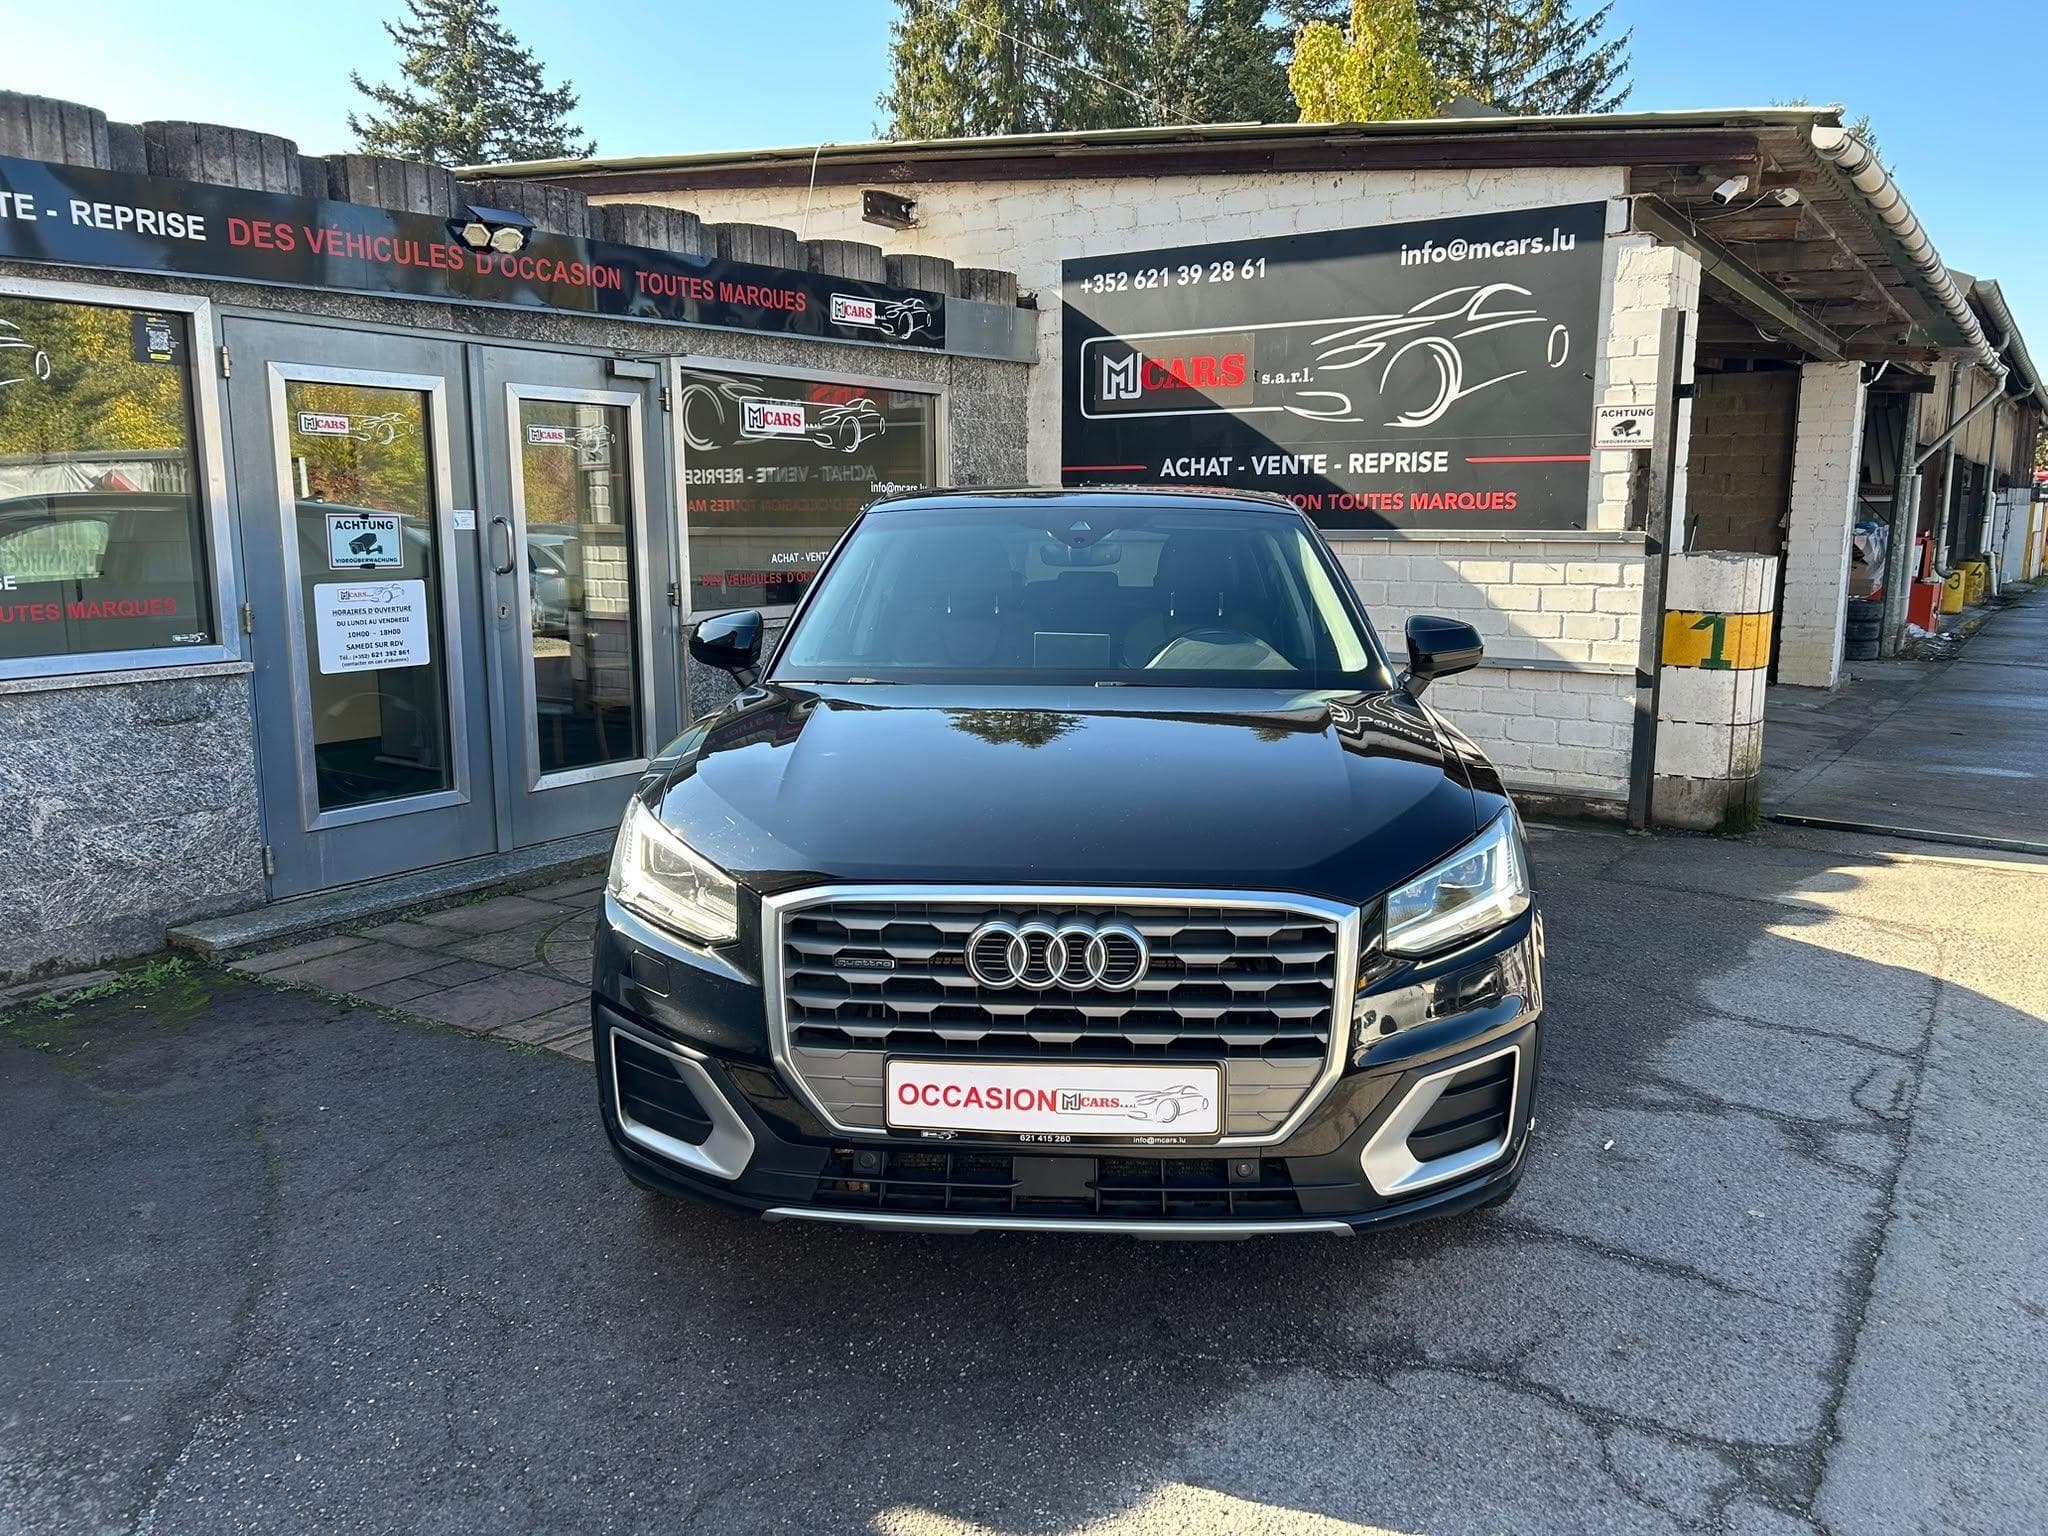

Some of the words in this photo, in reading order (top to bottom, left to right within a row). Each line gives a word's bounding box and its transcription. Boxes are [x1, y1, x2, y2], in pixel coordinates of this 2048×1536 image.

[46, 209, 58, 217] -
[69, 199, 207, 241] REPRISE
[1400, 227, 1576, 266] info@mcars.lu
[227, 217, 296, 252] DES
[303, 223, 464, 271] VÉHICULES
[475, 251, 622, 291] D'OCCASION
[635, 271, 715, 301] TOUTES
[719, 281, 808, 312] MARQUES
[1080, 271, 1128, 294] +352
[1134, 267, 1169, 290] 621
[1177, 264, 1203, 286] 39
[1208, 261, 1235, 283] 28
[1241, 257, 1266, 280] 61
[1261, 368, 1314, 384] s.a.r.l.
[1601, 408, 1654, 417] ACHTUNG
[1160, 457, 1233, 477] ACHAT
[1251, 454, 1328, 475] VENTE
[1348, 451, 1449, 473] REPRISE
[1328, 493, 1403, 511] TOUTES
[1410, 491, 1517, 511] MARQUES
[335, 520, 394, 530] ACHTUNG
[771, 552, 799, 564] ACHAT
[1969, 563, 1982, 578] 4
[1949, 572, 1961, 589] 3
[67, 596, 177, 620] MARQUES
[332, 608, 367, 616] HORAIRES
[346, 642, 373, 650] SAMEDI
[1688, 614, 1732, 670] 1
[898, 1083, 1056, 1112] OCCASION
[1020, 1134, 1034, 1142] 621
[1133, 1136, 1186, 1144] info@mcars.lu
